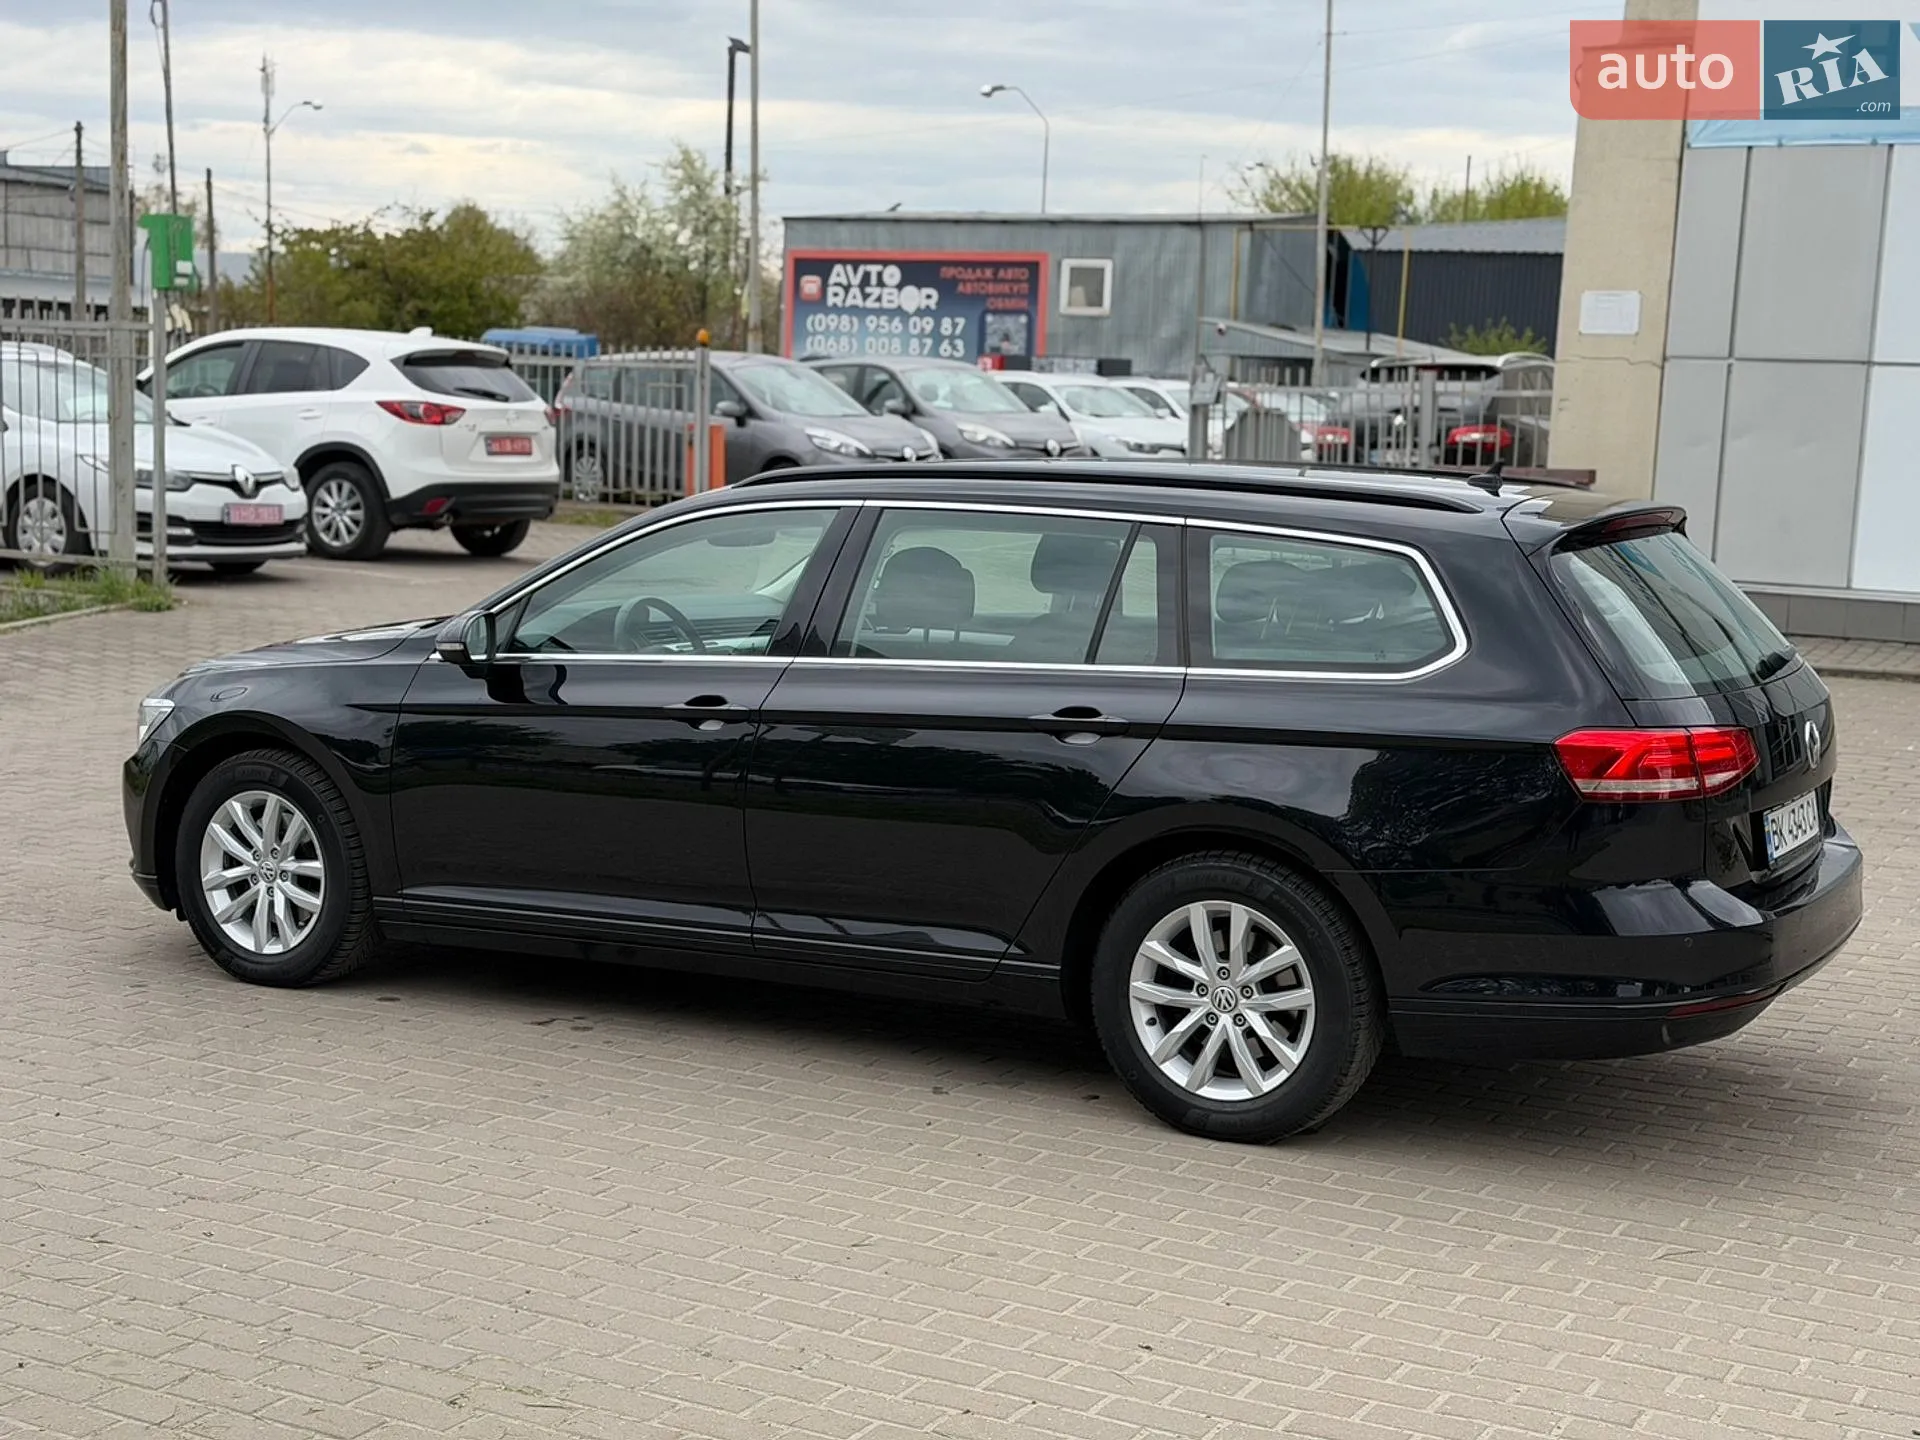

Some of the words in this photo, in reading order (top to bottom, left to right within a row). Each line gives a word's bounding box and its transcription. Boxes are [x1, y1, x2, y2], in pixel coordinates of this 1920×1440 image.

[828, 263, 902, 287] AVTO
[997, 268, 1029, 280] АВТО
[826, 285, 939, 314] RAZBOR
[806, 313, 859, 333] (098)
[865, 315, 903, 334] 956
[908, 316, 935, 335] 09
[940, 317, 966, 336] 87
[805, 334, 858, 353] (068)
[908, 337, 934, 356] 87
[939, 338, 965, 357] 63
